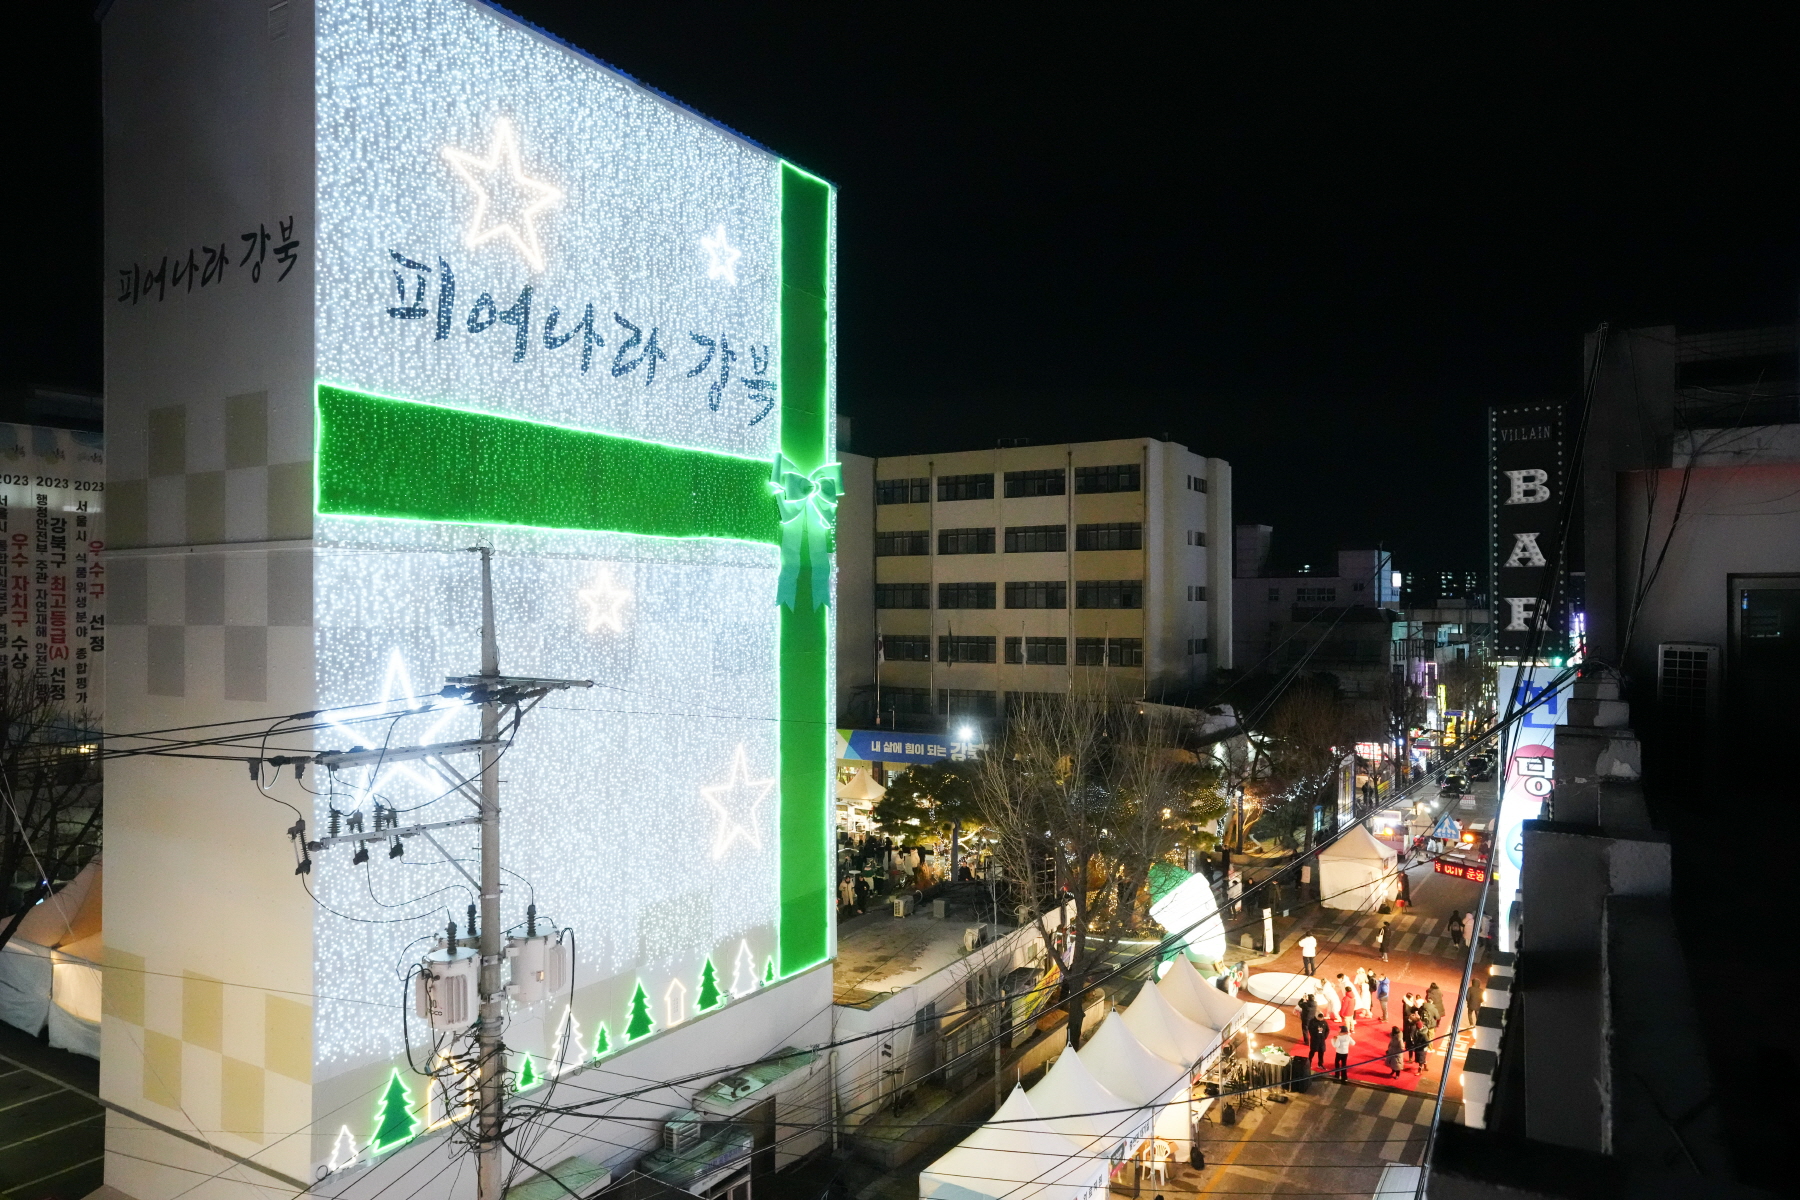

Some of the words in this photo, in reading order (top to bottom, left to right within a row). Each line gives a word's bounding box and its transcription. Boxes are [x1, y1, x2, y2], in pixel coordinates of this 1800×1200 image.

[118, 243, 229, 306] 피어나라
[240, 215, 300, 284] 강북
[386, 249, 667, 388] 피어나라
[686, 332, 778, 427] 강북
[1501, 425, 1551, 442] VILLAIN
[0, 474, 29, 487] 023
[36, 476, 69, 489] 2023
[74, 480, 104, 492] 2023
[36, 493, 49, 555] 행정안전부
[76, 500, 88, 542] 서울시
[11, 533, 29, 568] 우수
[50, 517, 68, 569] 강북구
[35, 560, 49, 585] 주관
[89, 540, 105, 599] 우수구
[11, 575, 30, 628] 자치구
[35, 588, 49, 638] 자연재해
[75, 552, 88, 638] 식품위생분야
[49, 576, 69, 661] 최고등급(A)
[89, 614, 105, 653] 선정
[11, 635, 29, 670] 수상
[35, 642, 49, 679] 안전도
[50, 666, 67, 701] 선정
[75, 647, 88, 704] 종합평가
[871, 741, 881, 753] 내
[883, 741, 903, 754] 삶에
[905, 742, 925, 756] 힘이
[927, 744, 947, 757] 되는
